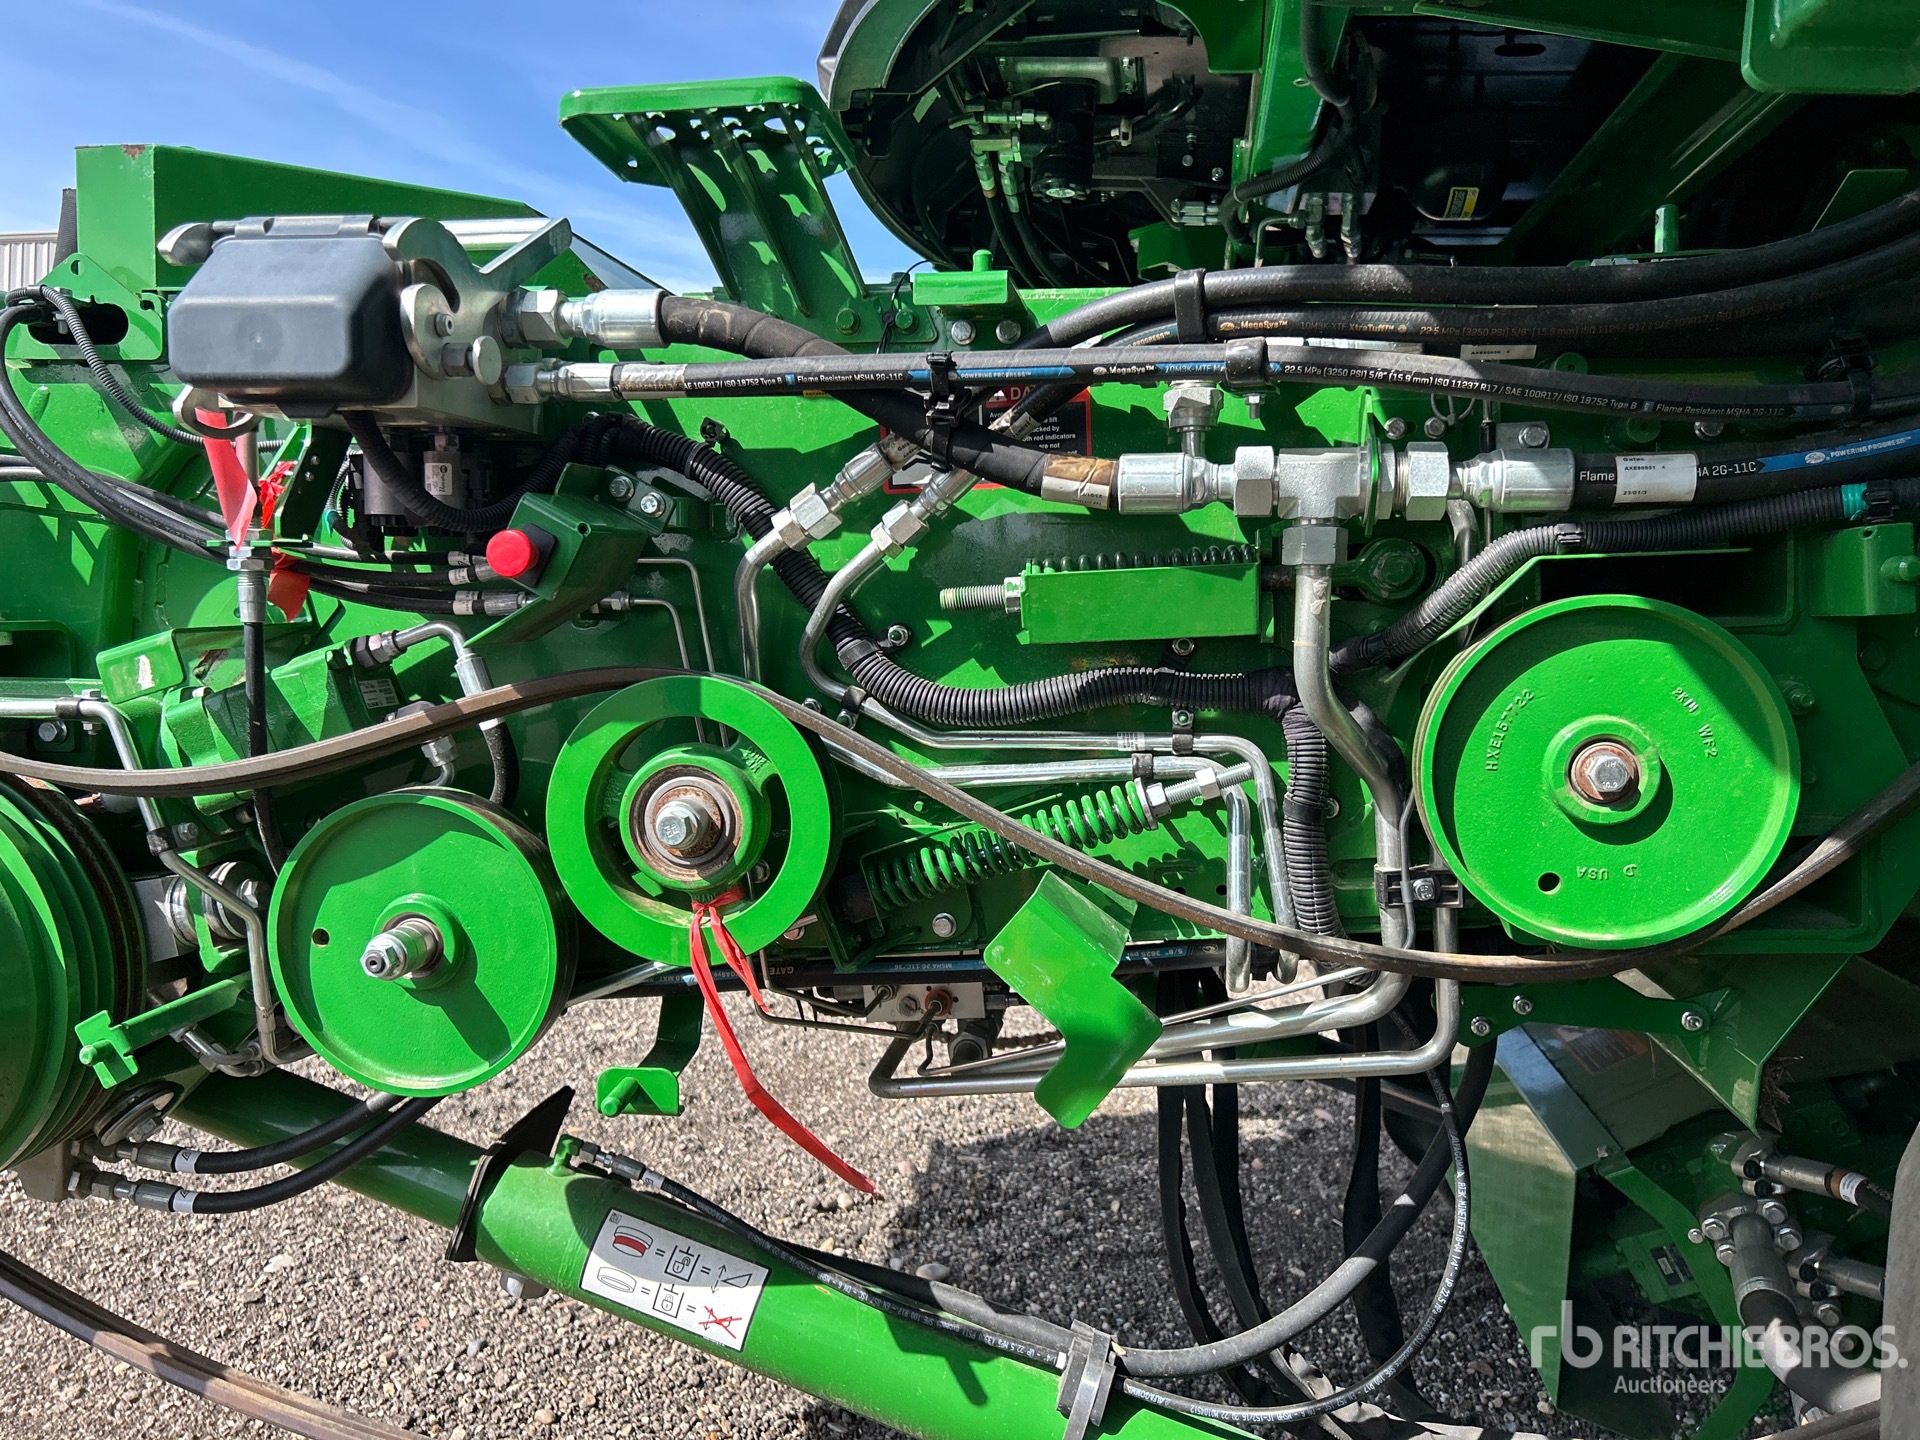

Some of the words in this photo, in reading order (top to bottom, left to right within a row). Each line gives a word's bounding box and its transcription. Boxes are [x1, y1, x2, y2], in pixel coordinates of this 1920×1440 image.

[1420, 326, 1440, 335] 22.5
[1441, 327, 1461, 335] MPa
[760, 376, 776, 386] Type
[776, 376, 783, 385] B
[796, 375, 819, 384] Flame
[819, 374, 852, 383] Resistant
[853, 373, 875, 382] MSHA
[1284, 364, 1303, 375] 22.5
[1304, 366, 1322, 376] MPa
[1323, 366, 1349, 378] (3250
[1349, 368, 1367, 380] PSI)
[1412, 375, 1433, 386] mm)
[1434, 376, 1450, 388] ISO
[1451, 378, 1480, 391] 11237
[1480, 382, 1498, 393] R17
[1505, 386, 1522, 397] SAE
[1563, 393, 1578, 403] ISO
[1579, 395, 1608, 407] 18752
[1609, 399, 1629, 410] Type
[1630, 401, 1638, 410] B
[1655, 403, 1683, 414] Flame
[1684, 405, 1726, 416] Resistant
[1726, 407, 1751, 417] MSHA
[1051, 425, 1060, 433] by
[1044, 433, 1077, 441] indicators
[1830, 445, 1868, 459] POWERING
[1713, 461, 1757, 477] 2G-11C
[1579, 470, 1615, 482] Flame
[1575, 865, 1610, 880] USA
[1450, 1134, 1465, 1179] ALFAGOMMA
[1125, 1384, 1166, 1404] ALFAGOMMA
[1220, 1410, 1229, 1419] 22
